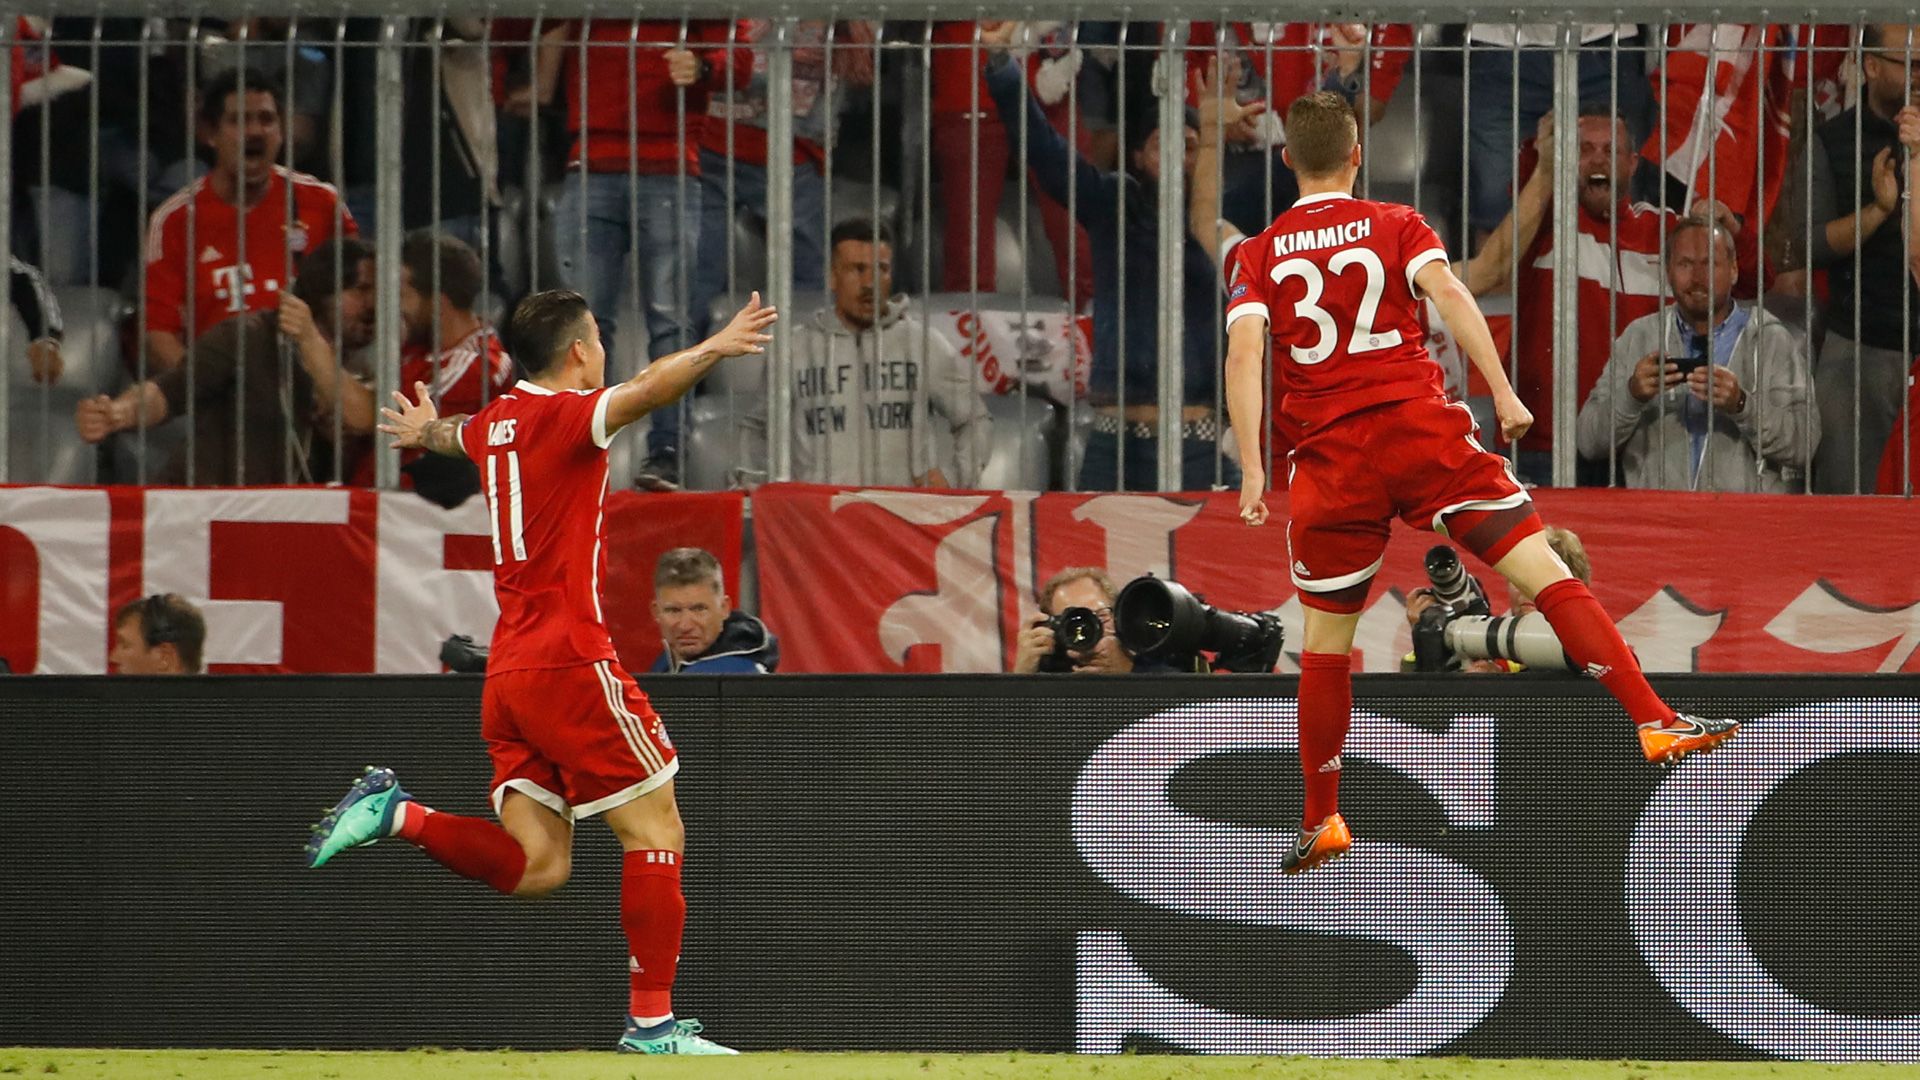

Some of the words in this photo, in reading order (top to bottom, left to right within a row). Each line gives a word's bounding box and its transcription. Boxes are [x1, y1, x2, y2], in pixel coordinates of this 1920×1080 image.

[1274, 217, 1371, 257] KIMMICH
[1270, 247, 1403, 365] 32
[805, 405, 846, 436] NEW
[866, 402, 915, 431] YORK
[487, 450, 528, 565] 11
